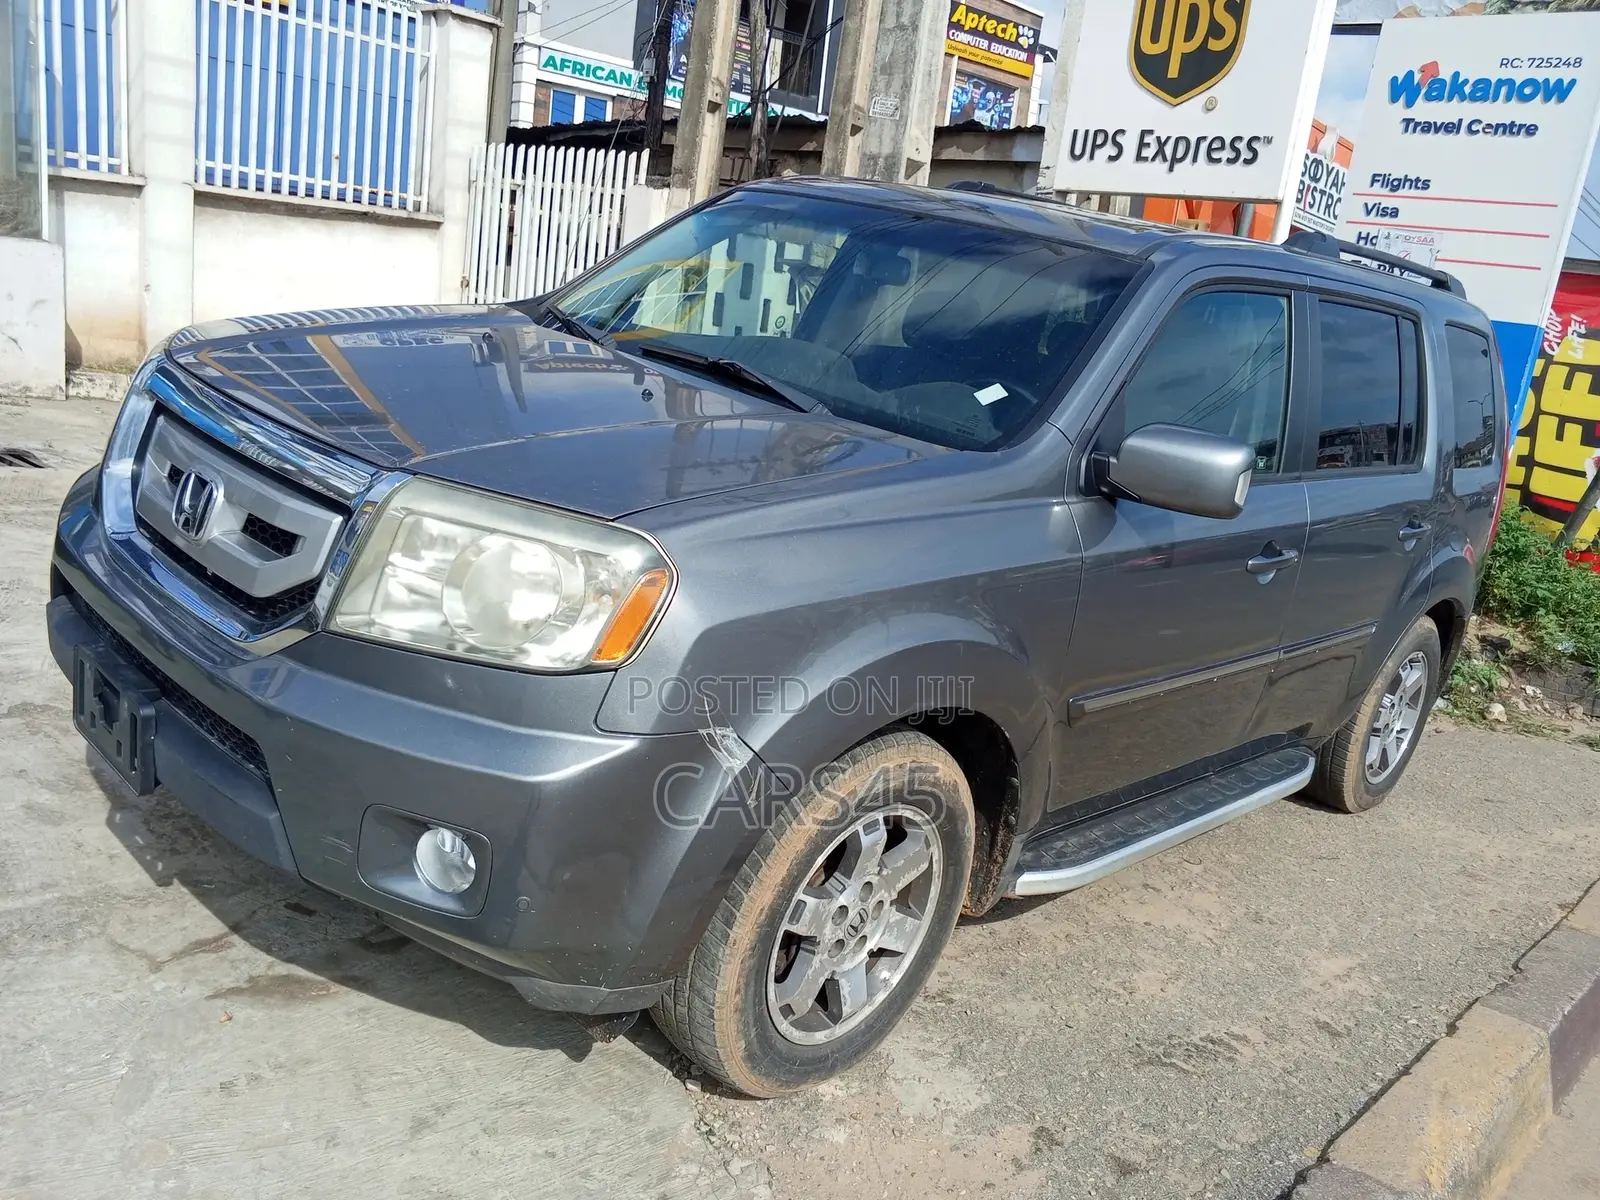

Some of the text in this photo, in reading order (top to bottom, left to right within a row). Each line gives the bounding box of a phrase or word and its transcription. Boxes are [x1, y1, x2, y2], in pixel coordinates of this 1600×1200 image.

[951, 4, 1018, 42] Aptech
[949, 30, 1028, 62] COMPUTER EDUCATION
[968, 51, 980, 59] your
[542, 55, 633, 87] AFRICAN
[1499, 57, 1583, 69] RC: 725248
[1389, 69, 1577, 108] Wakanow
[1400, 118, 1539, 136] Travel Centre
[1069, 128, 1127, 162] UPS
[1369, 173, 1432, 192] Flights
[1363, 202, 1400, 219] Visa
[1543, 308, 1563, 356] CHOP
